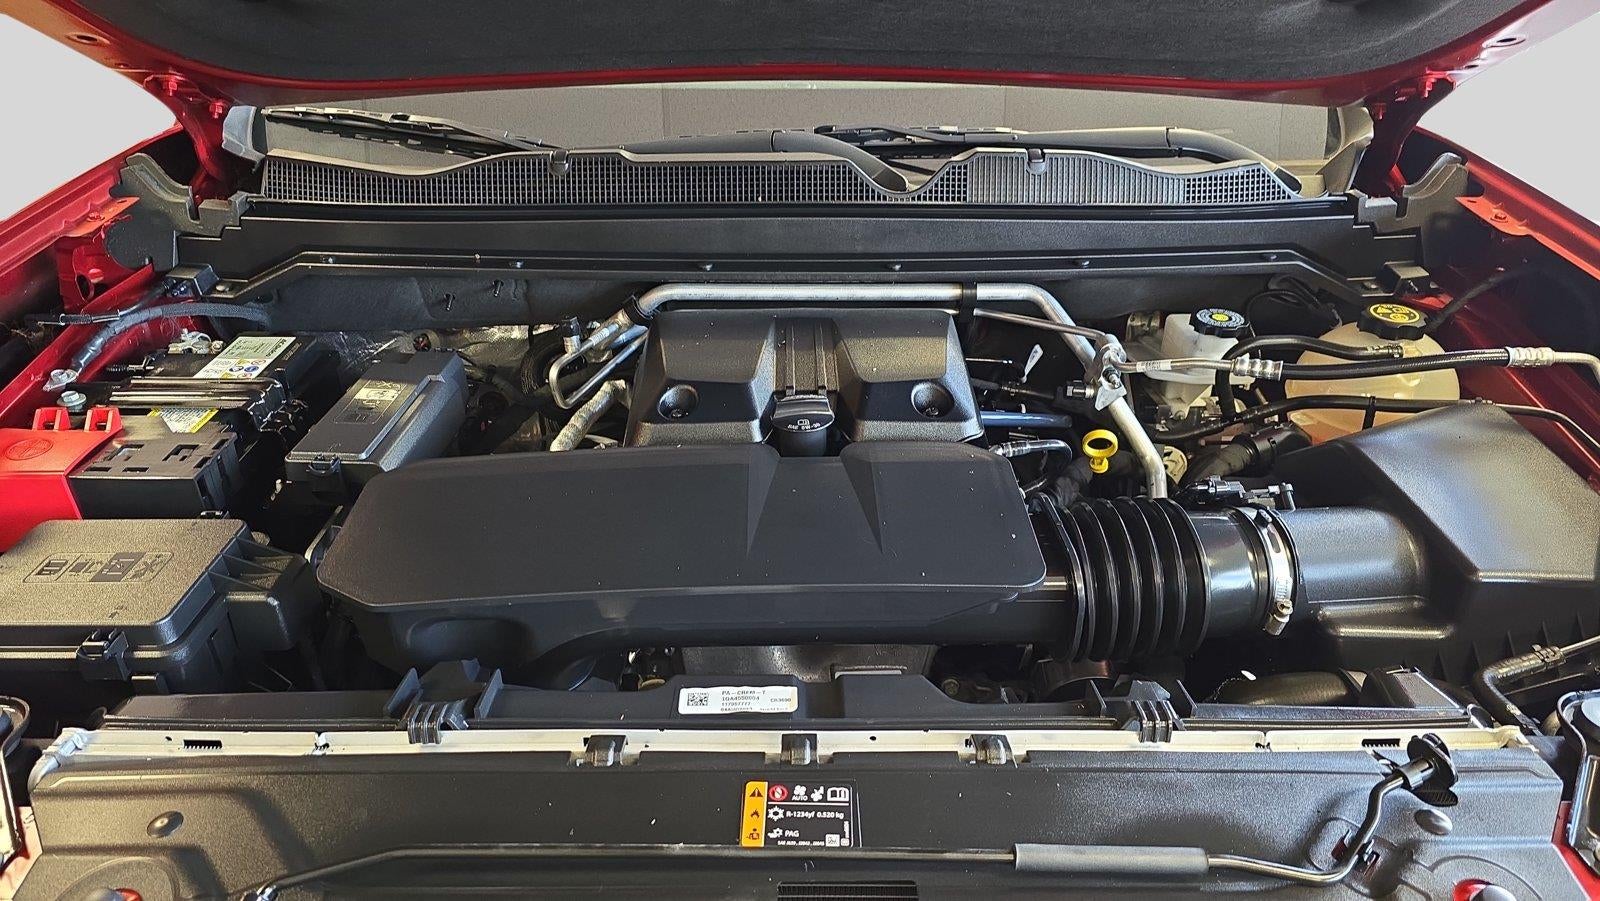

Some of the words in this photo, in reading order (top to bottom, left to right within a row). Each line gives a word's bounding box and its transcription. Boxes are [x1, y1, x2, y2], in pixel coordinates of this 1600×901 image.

[785, 811, 815, 819] R-1234yf
[835, 811, 845, 820] kg
[784, 830, 800, 838] PAG
